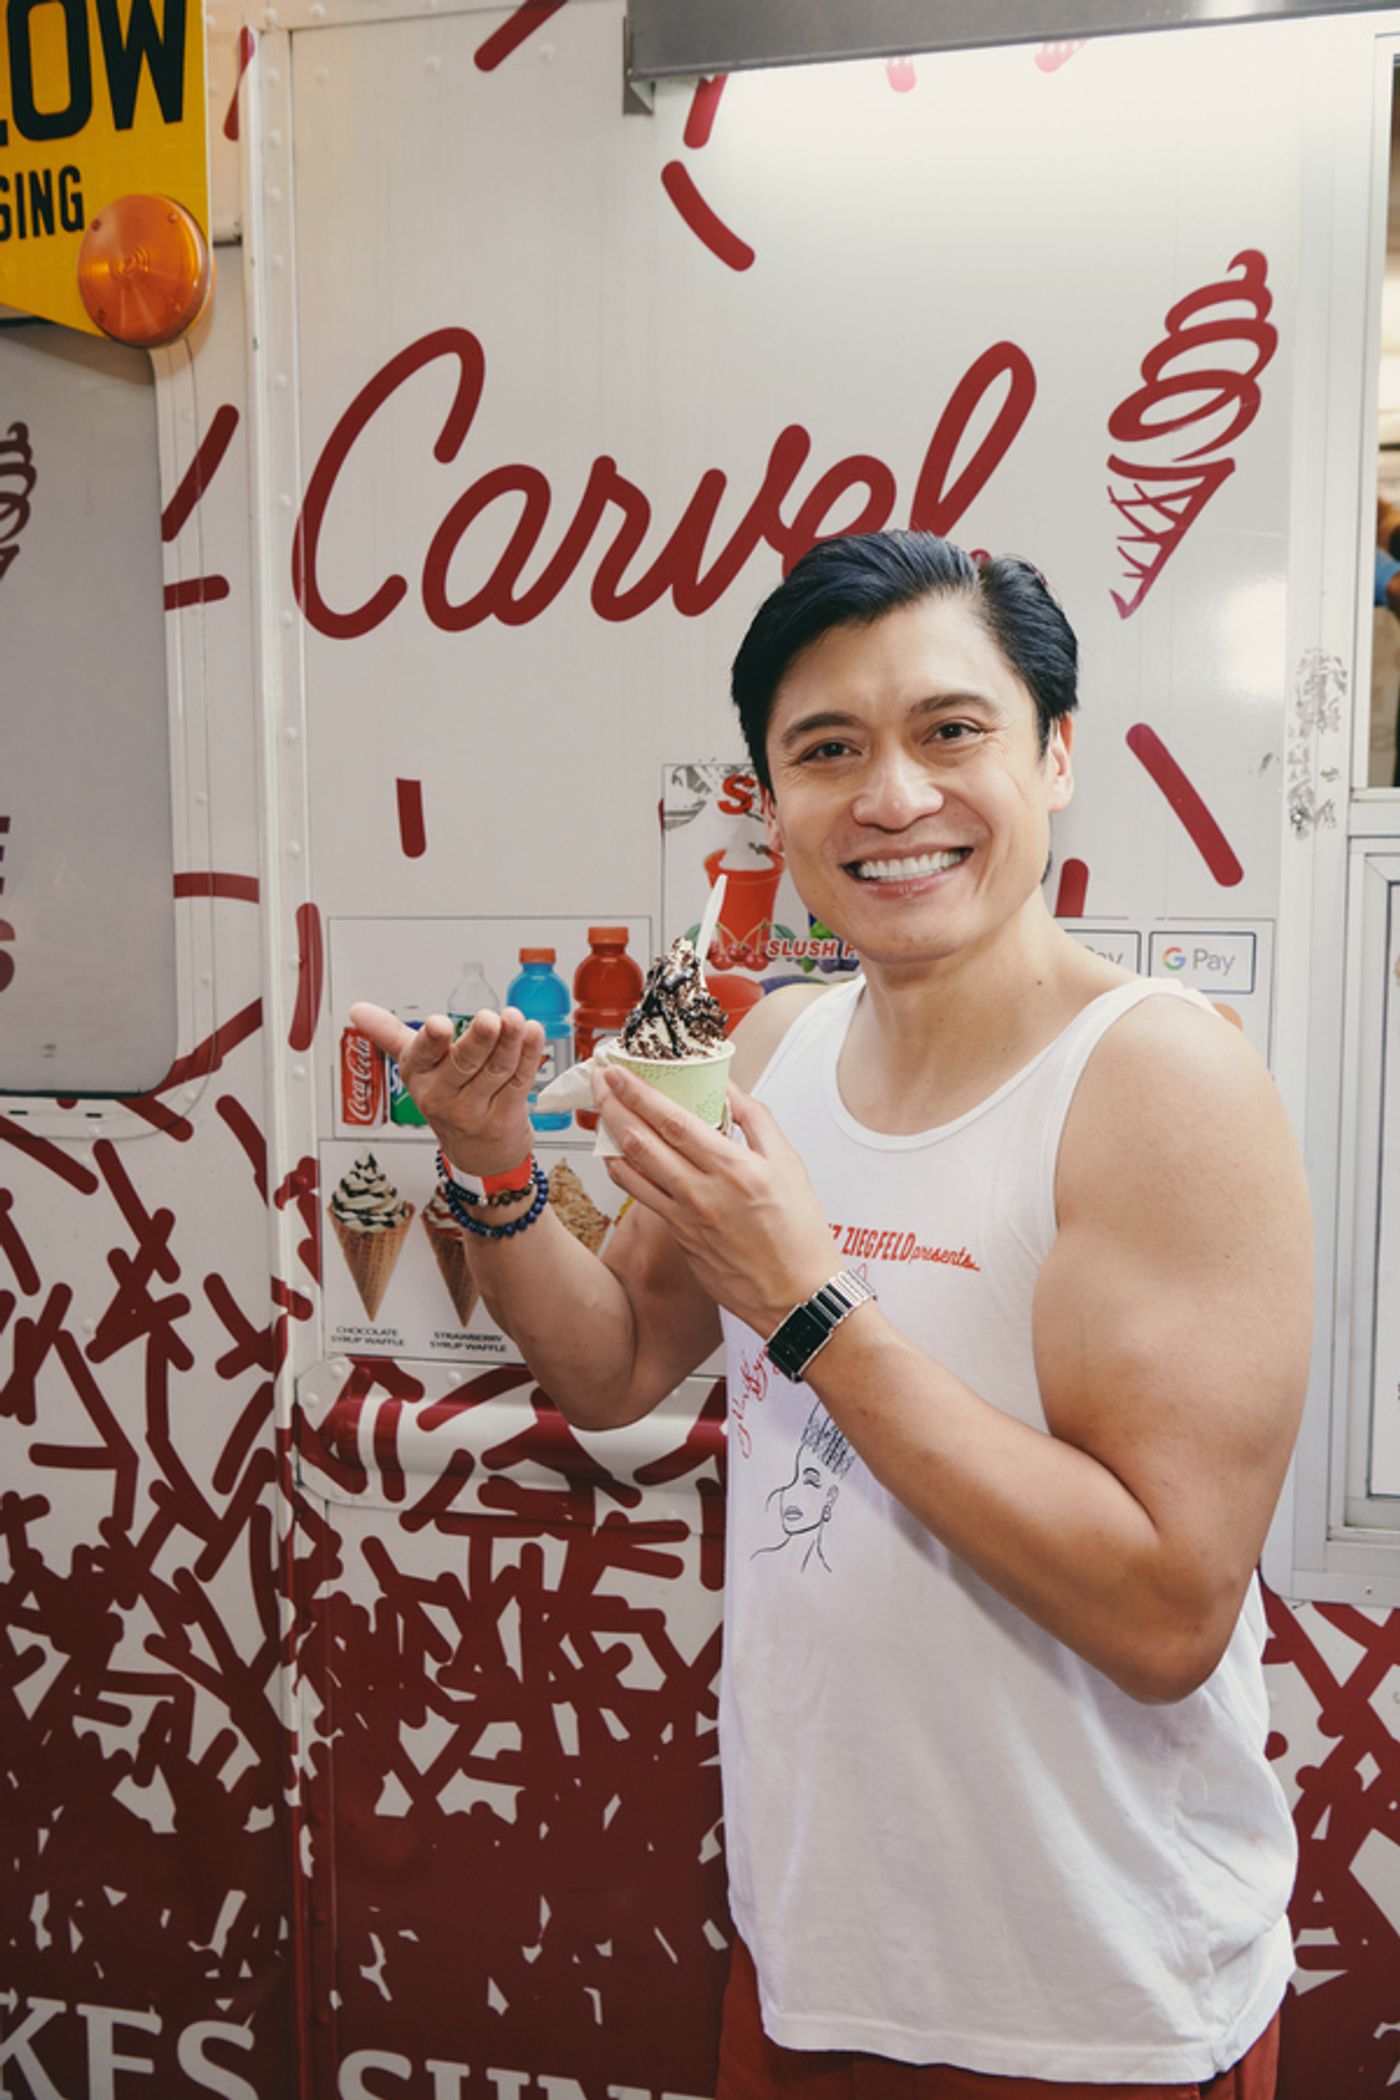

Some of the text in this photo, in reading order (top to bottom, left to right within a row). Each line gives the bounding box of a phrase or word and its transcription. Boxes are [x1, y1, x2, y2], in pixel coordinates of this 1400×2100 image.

[0, 0, 187, 146] OW
[292, 326, 1038, 640] Carvel
[768, 940, 837, 957] SLUSH
[1193, 948, 1236, 977] Pay
[841, 1226, 916, 1262] ZIEGFELD
[336, 1326, 398, 1337] CHOCOLATE
[433, 1331, 503, 1342] STRAWBERRY
[331, 1335, 404, 1347] SYRUP WAFFLE
[430, 1341, 507, 1352] SYRUP WAFFLE
